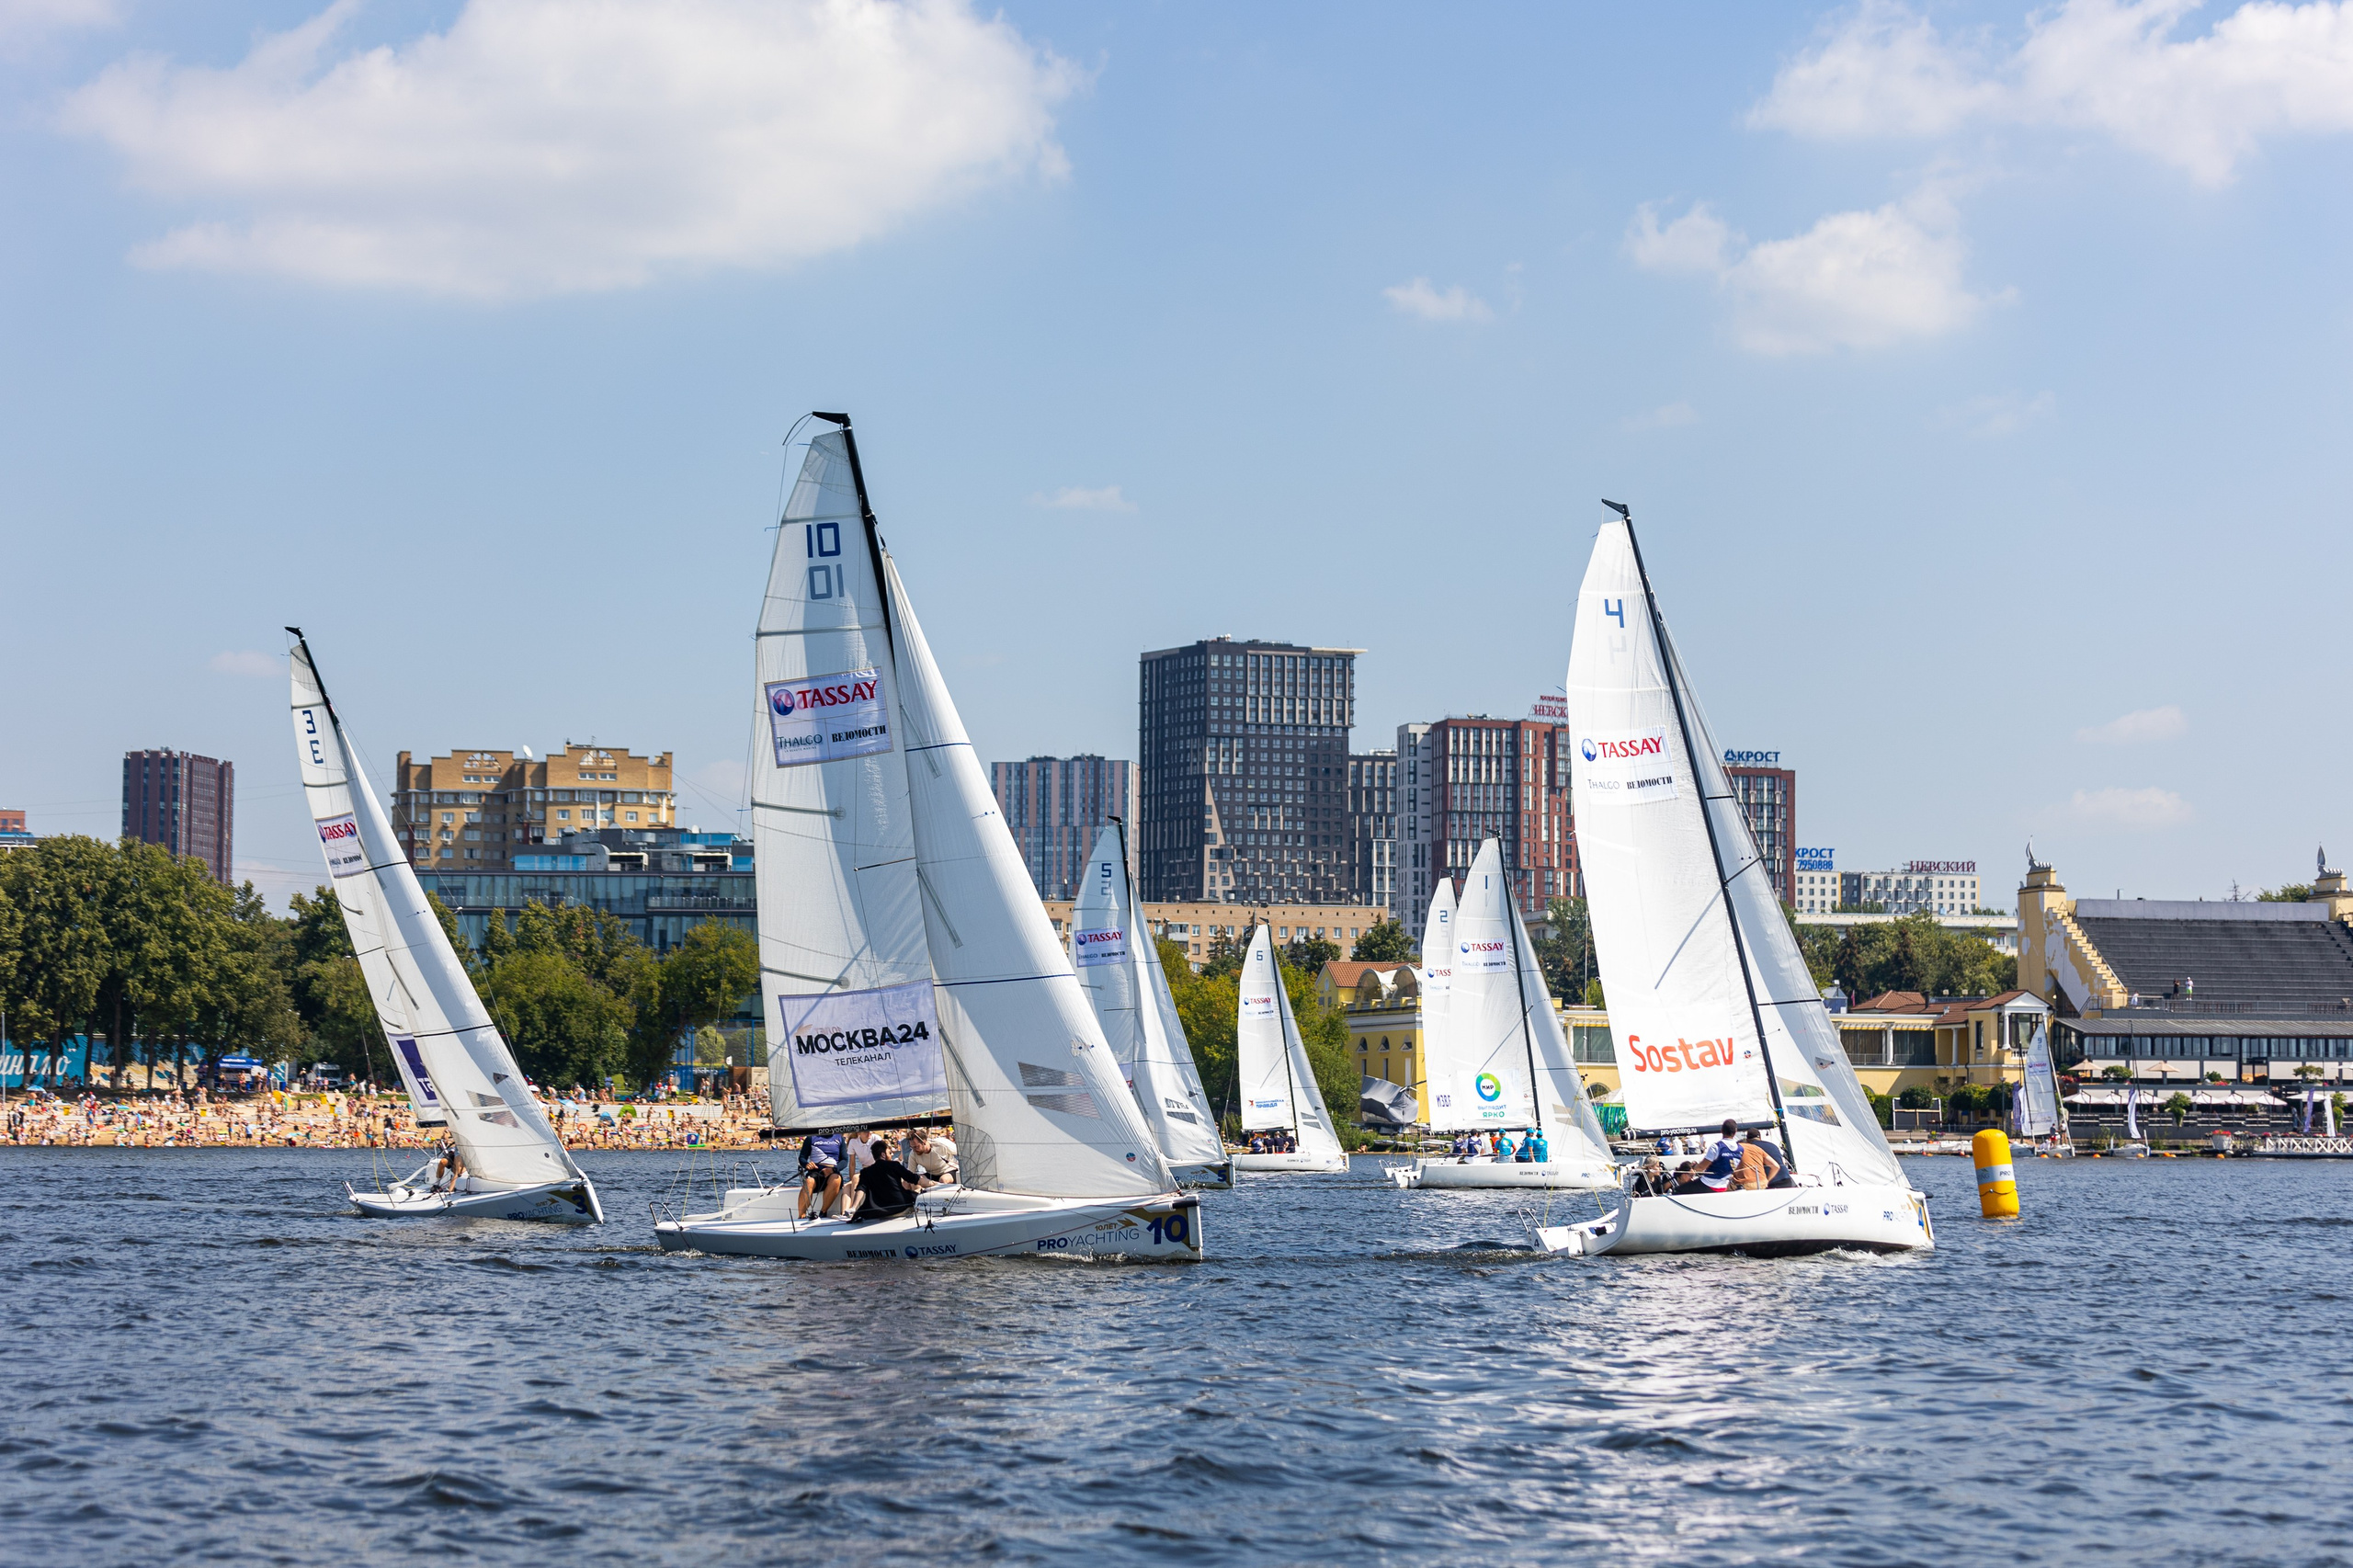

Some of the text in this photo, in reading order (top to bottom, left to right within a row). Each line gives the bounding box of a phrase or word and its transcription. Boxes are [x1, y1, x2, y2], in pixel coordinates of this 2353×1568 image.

[805, 522, 841, 558] 10
[1604, 598, 1625, 628] 4
[796, 679, 878, 709] TASSAY
[301, 710, 316, 734] 3
[777, 724, 887, 749] THALGO ВЕДОМОСТИ
[1597, 735, 1663, 758] TASSAY
[1737, 751, 1780, 763] КРОСТ
[1587, 776, 1673, 790] THALGO ВЕДОМОСТИ
[323, 822, 358, 840] TASSAY
[1101, 863, 1112, 878] 5
[1797, 859, 1834, 870] 7950888
[1909, 860, 1976, 873] НЕВСКИЙ
[1439, 910, 1449, 923] 2
[1087, 931, 1123, 943] TASSAY
[1471, 942, 1505, 952] TASSAY
[1256, 950, 1264, 961] 6
[1250, 996, 1272, 1005] TASSAY
[835, 1051, 892, 1066] ТЕЛЕКАНАЛ
[1628, 1034, 1734, 1073] Sostav
[818, 1124, 868, 1135] pro-yachting.ru
[1660, 1127, 1698, 1136] pro-yachting.ru
[1217, 1169, 1227, 1182] 5
[572, 1194, 588, 1215] 3
[1788, 1204, 1849, 1215] ВЕДОМОСТИ TASSAY
[506, 1204, 563, 1221] PROYACHTING
[1146, 1214, 1188, 1245] 10
[1037, 1228, 1140, 1251] PROYACHTING
[846, 1244, 957, 1258] ВЕДОМОСТИ TASSAY
